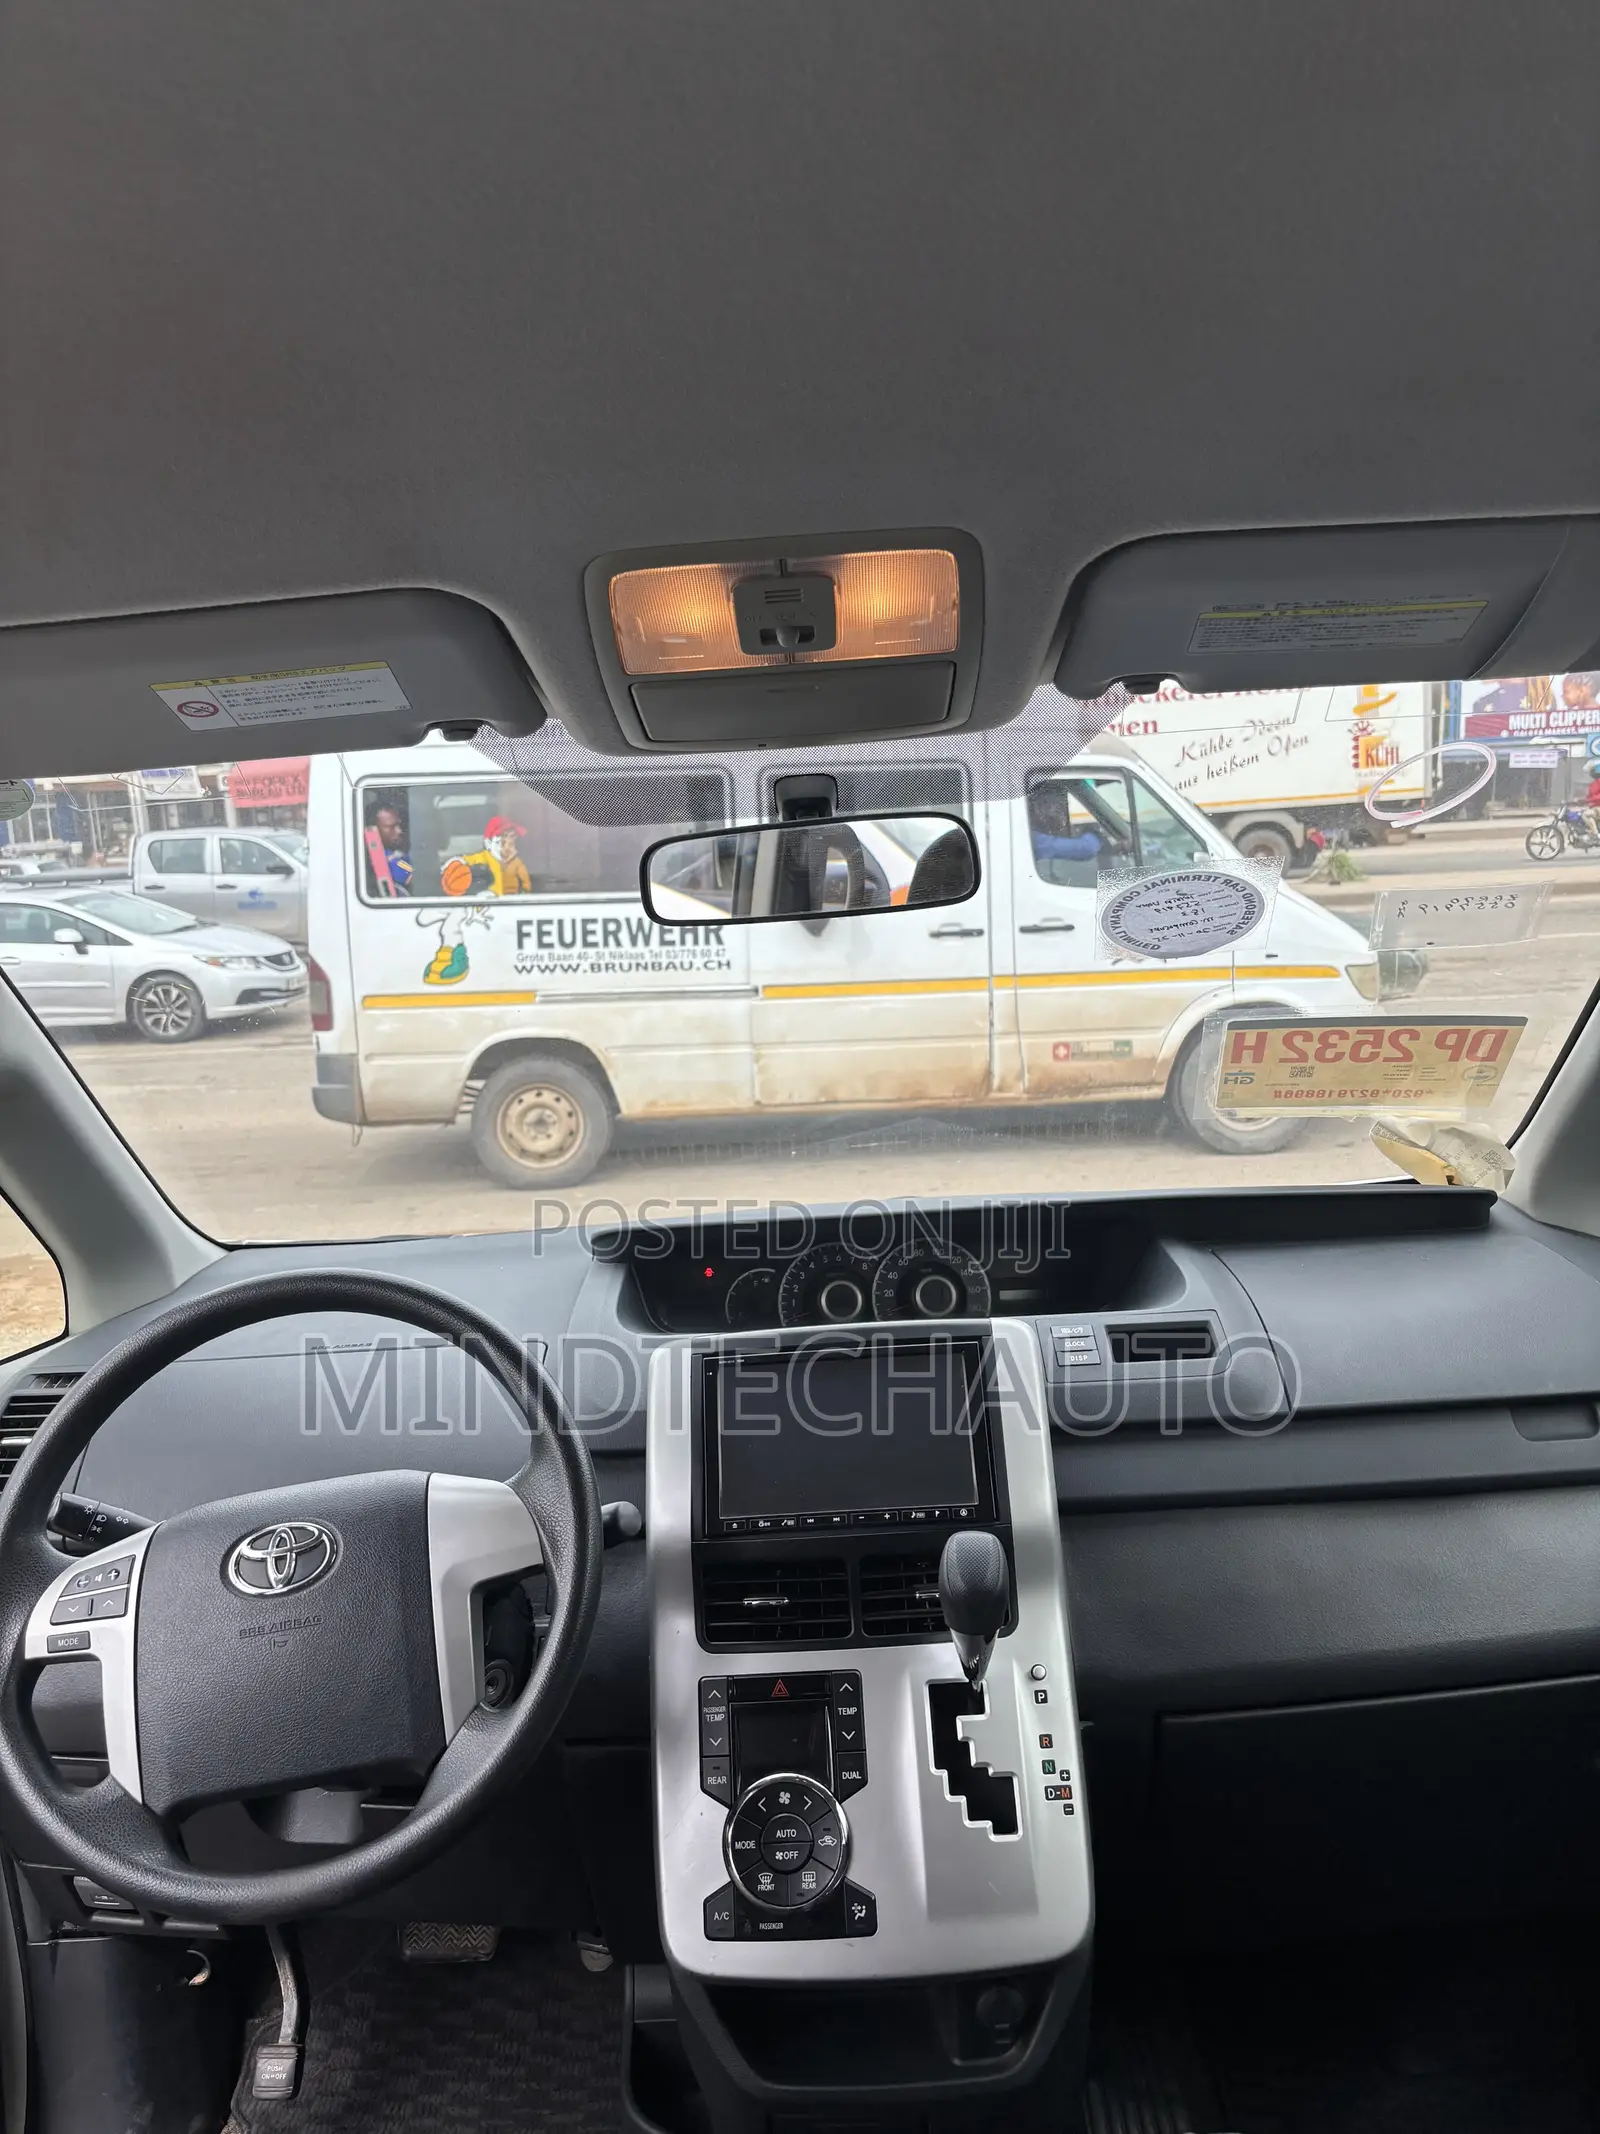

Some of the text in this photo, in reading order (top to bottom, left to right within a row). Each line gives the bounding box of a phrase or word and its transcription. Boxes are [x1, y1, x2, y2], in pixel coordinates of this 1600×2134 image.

[1508, 712, 1547, 731] MULTI
[515, 916, 724, 950] FEUERWEHR
[897, 1257, 909, 1266] 60
[949, 1256, 962, 1264] 120
[887, 1271, 899, 1280] 40
[883, 1289, 895, 1297] 20
[968, 1285, 981, 1294] 160
[1064, 1340, 1086, 1348] CLOCK
[1069, 1354, 1088, 1362] DISP
[57, 1636, 80, 1647] MODE
[1037, 1692, 1045, 1703] P
[838, 1707, 858, 1716] TEMP
[705, 1713, 725, 1722] TEMP
[1042, 1736, 1050, 1747] R
[1044, 1761, 1053, 1773] N
[841, 1771, 862, 1780] DUAL
[707, 1776, 728, 1785] REAR
[775, 1829, 797, 1838] AUTO
[734, 1840, 756, 1850] MODE
[783, 1851, 799, 1860] OFF
[757, 1882, 775, 1891] FRONT
[801, 1881, 817, 1890] REAR
[713, 1911, 730, 1921] A/C
[759, 1922, 784, 1931] PASSENGER
